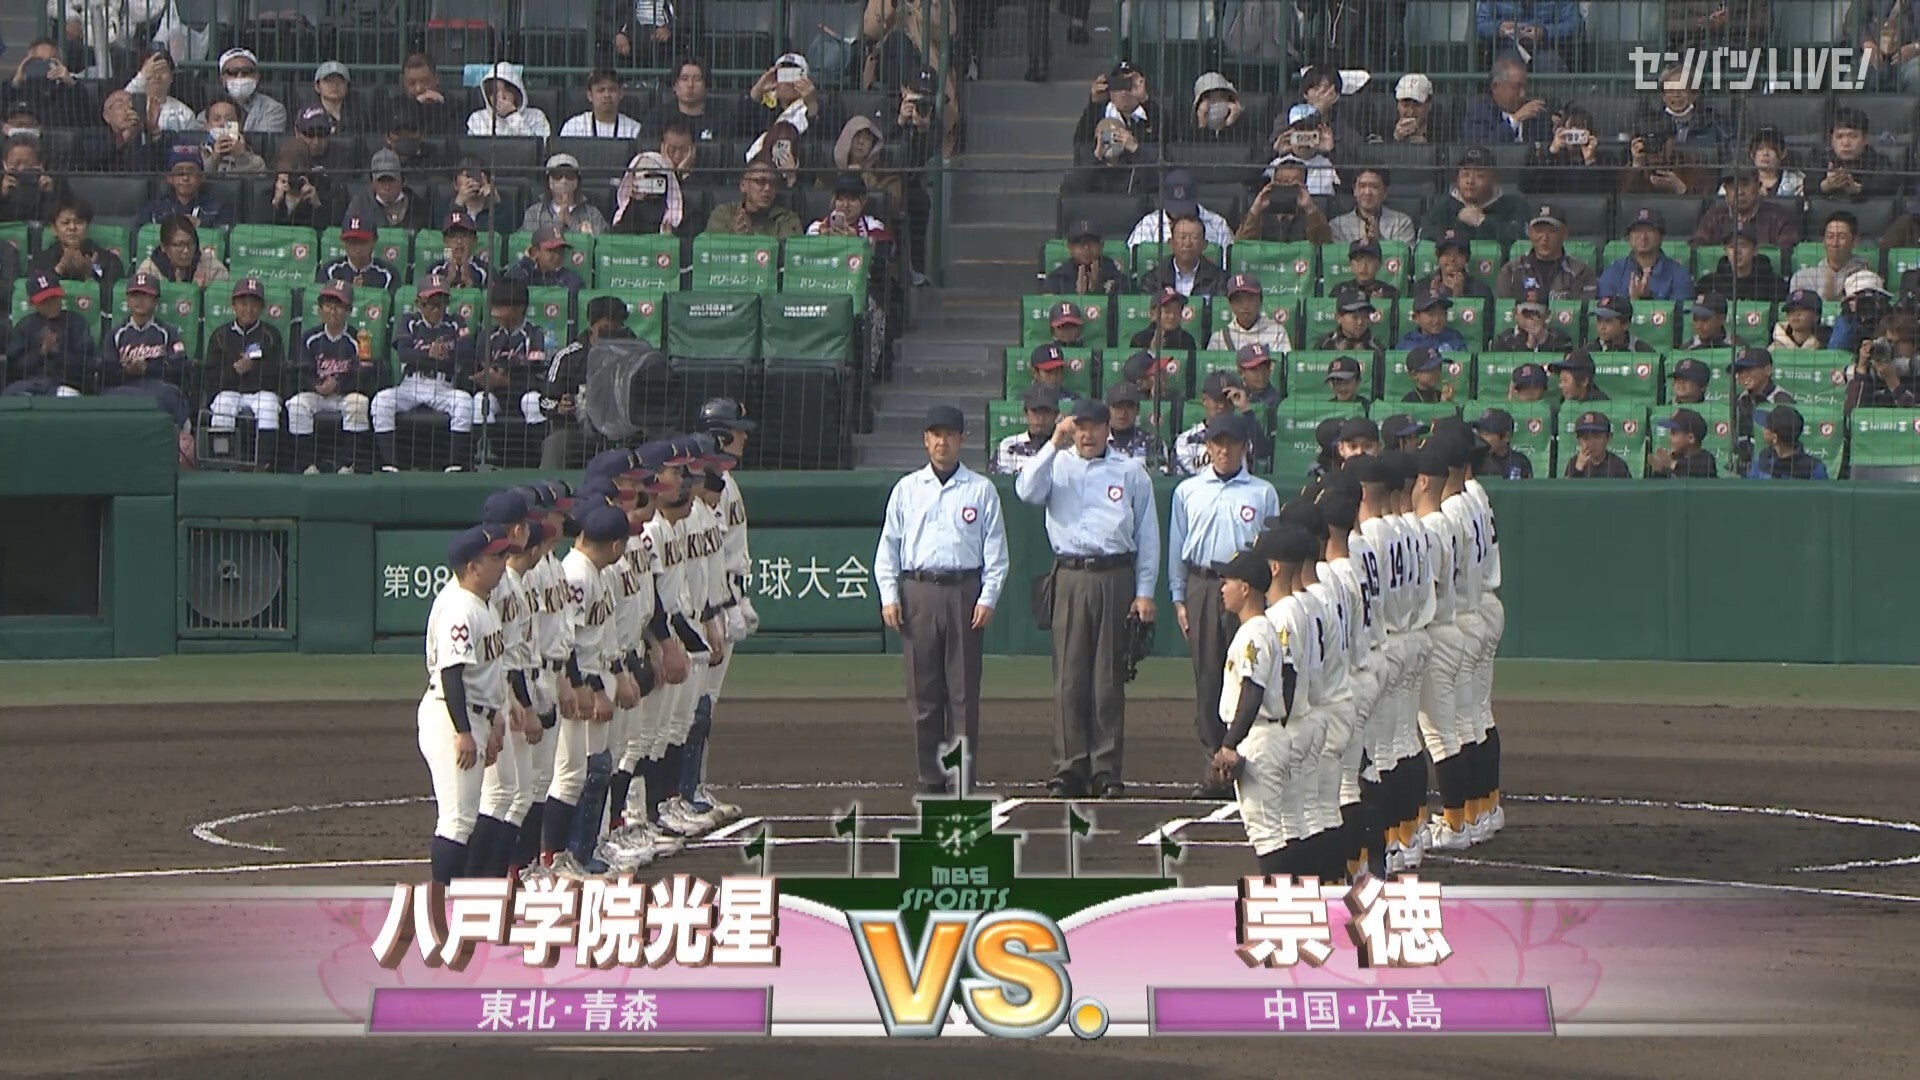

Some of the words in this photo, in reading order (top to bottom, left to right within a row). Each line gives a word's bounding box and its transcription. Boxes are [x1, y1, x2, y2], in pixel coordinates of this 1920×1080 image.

[743, 555, 869, 600] 球大会
[1389, 541, 1404, 589] 14
